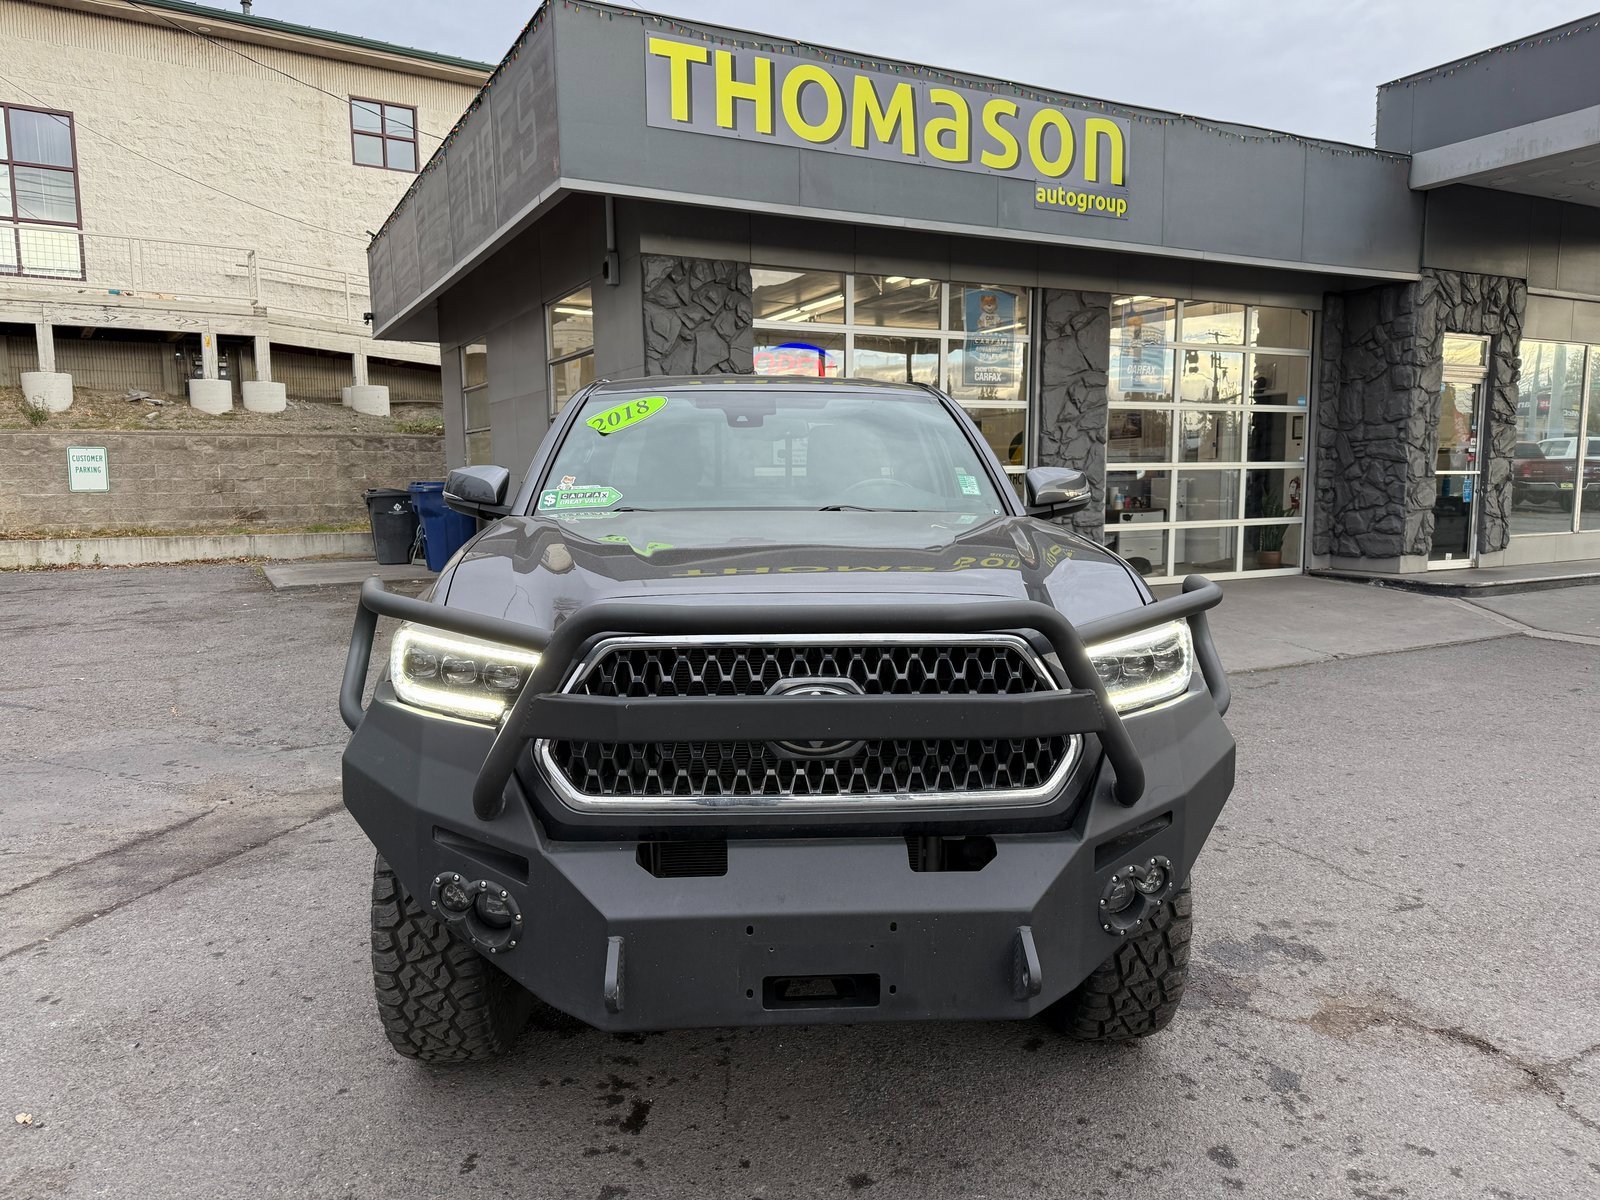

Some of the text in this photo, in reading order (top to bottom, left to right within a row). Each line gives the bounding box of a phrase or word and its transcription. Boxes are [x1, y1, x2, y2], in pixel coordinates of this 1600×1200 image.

[1035, 184, 1128, 218] autogroup
[1127, 364, 1155, 375] CARFAX
[974, 372, 1002, 382] CARFAX
[592, 399, 650, 431] 2018
[71, 454, 103, 462] CUSTOMER
[75, 466, 102, 474] PARKING
[561, 490, 609, 499] CARFAX
